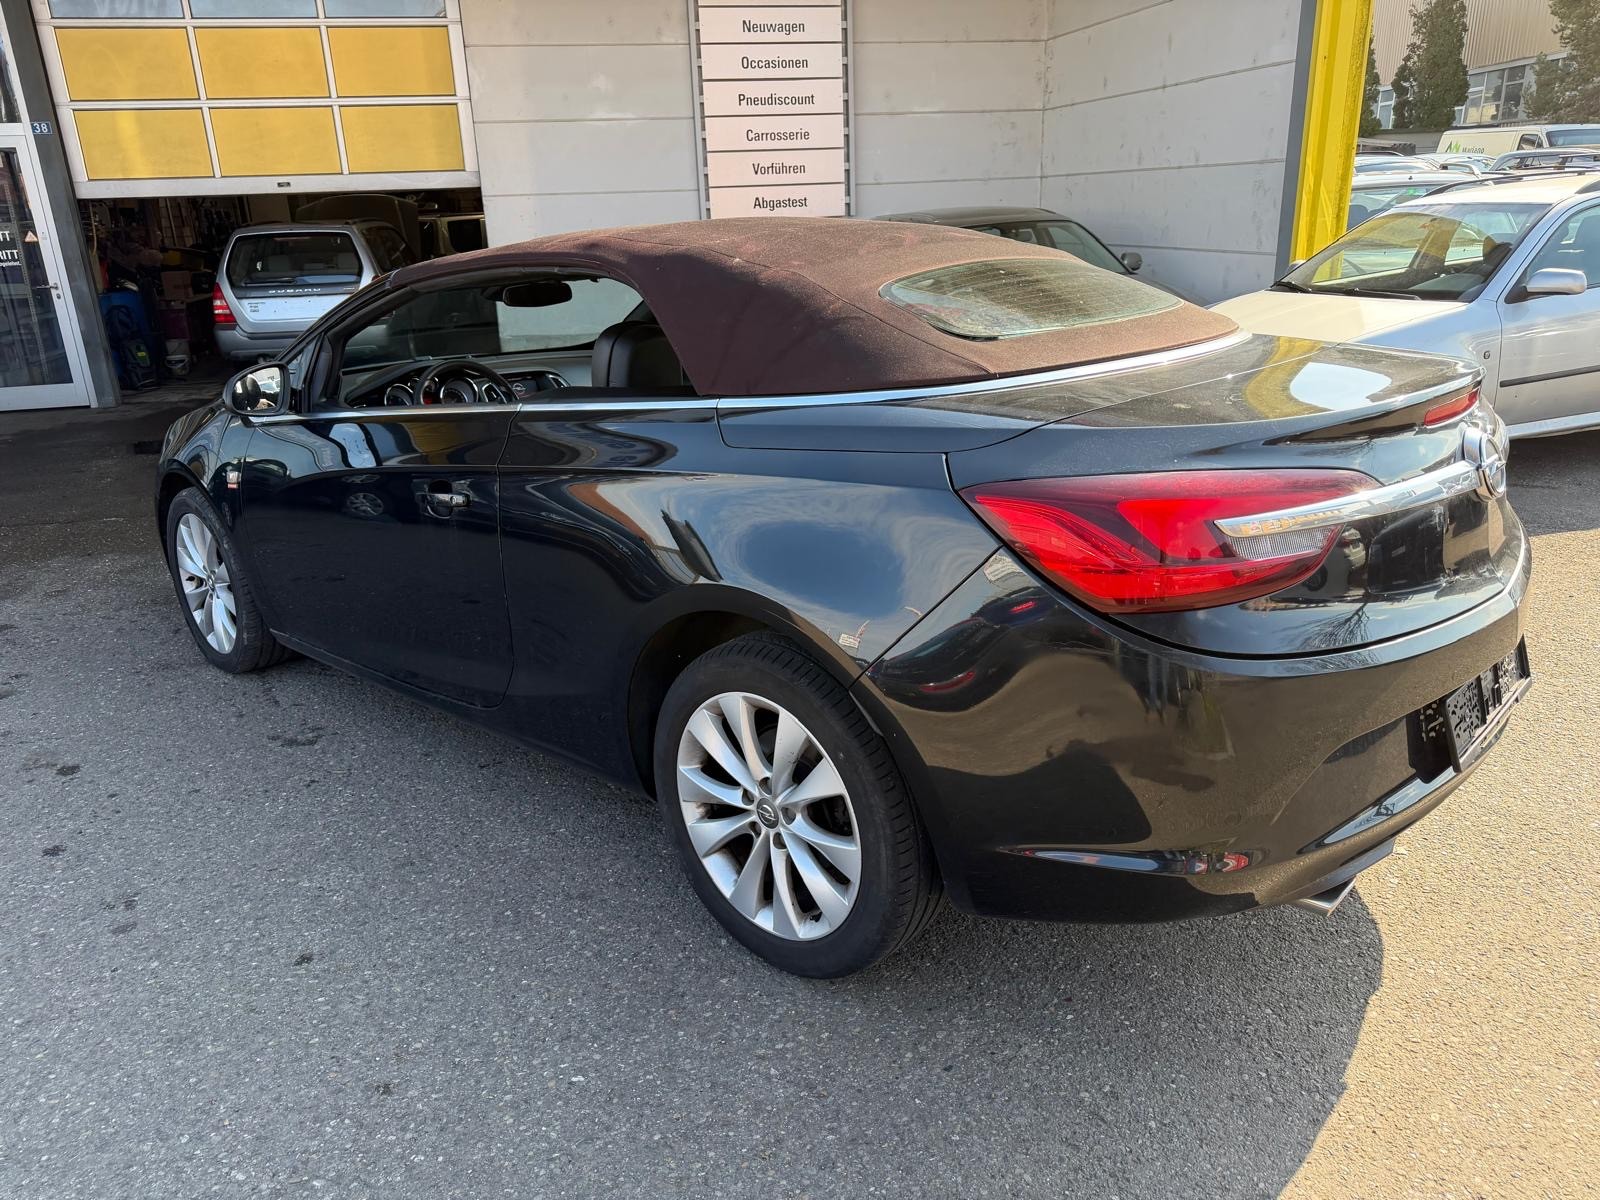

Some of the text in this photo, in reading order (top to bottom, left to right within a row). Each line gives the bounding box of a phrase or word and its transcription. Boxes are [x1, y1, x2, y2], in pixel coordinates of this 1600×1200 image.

[742, 19, 805, 36] Neuwagen
[741, 55, 809, 70] Occasionen
[738, 92, 815, 106] Pneudiscount
[33, 122, 48, 133] 38
[746, 127, 810, 142] Carrosserie
[752, 162, 806, 176] Vorführen
[753, 196, 808, 212] Abgastest
